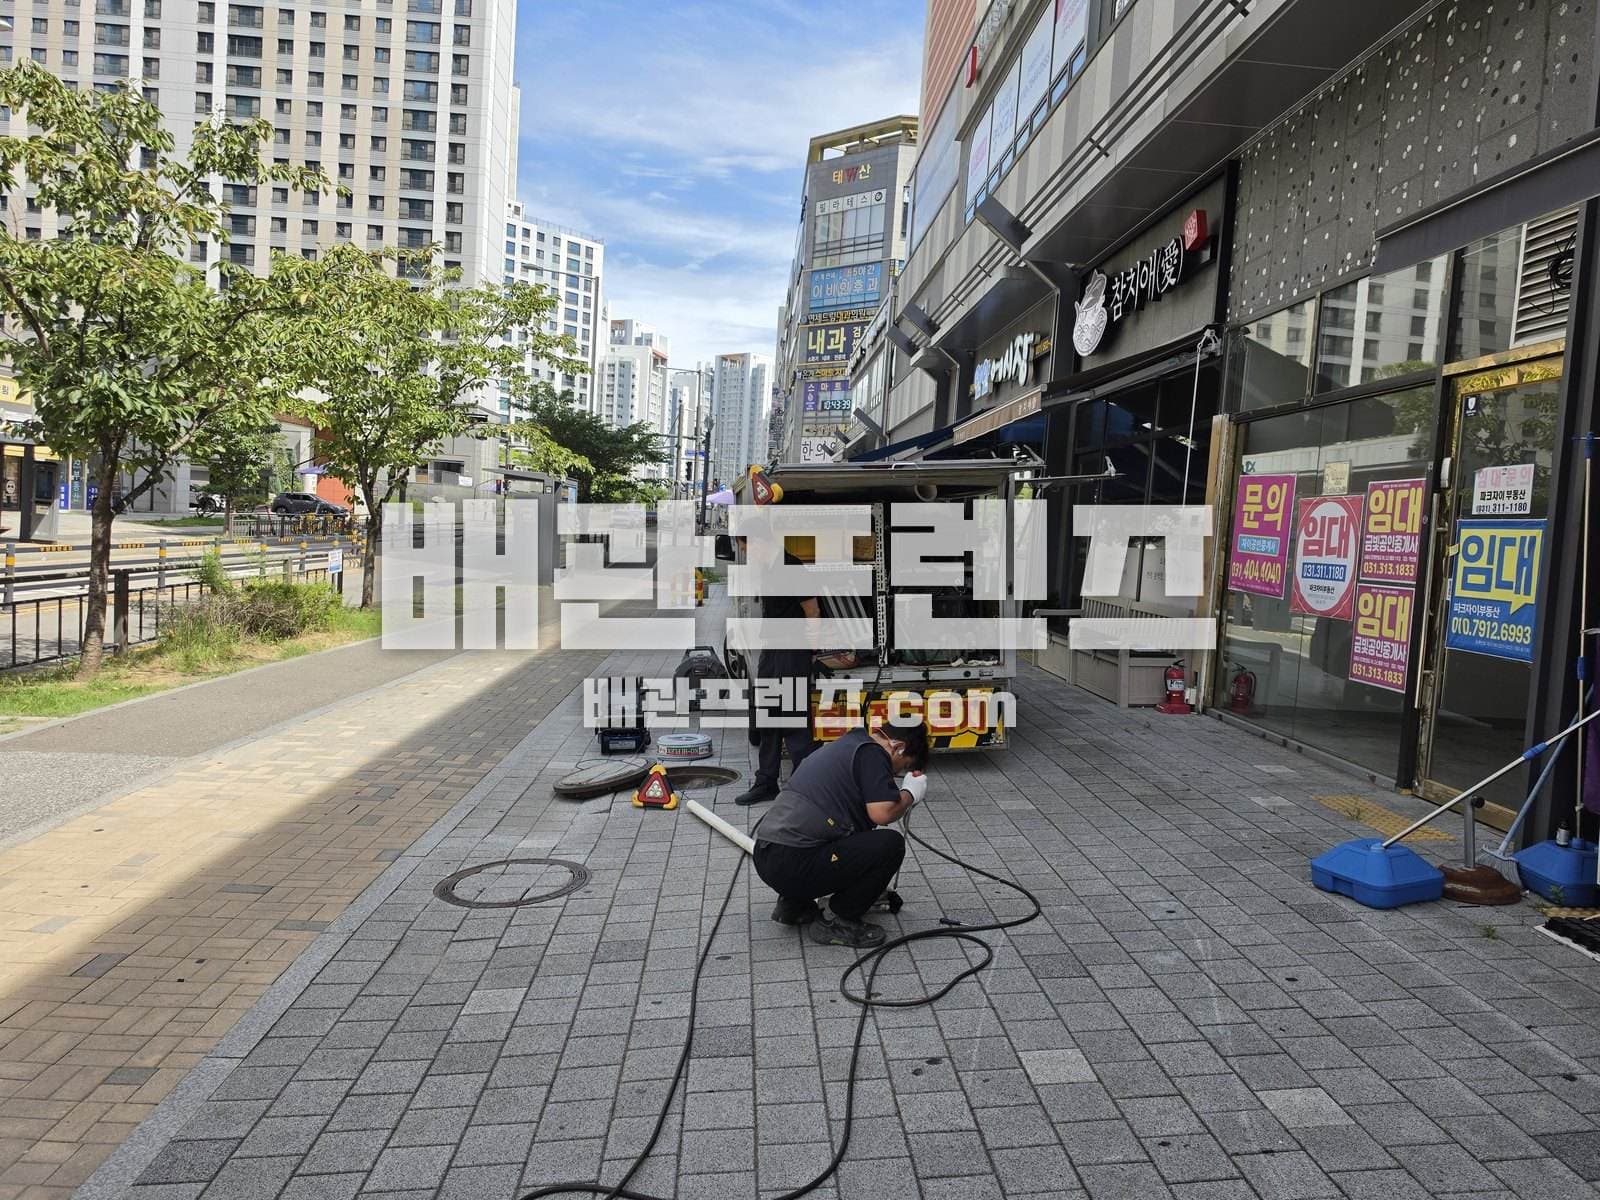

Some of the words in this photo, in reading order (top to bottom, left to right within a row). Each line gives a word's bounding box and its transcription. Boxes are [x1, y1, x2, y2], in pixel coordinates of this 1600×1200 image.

[1110, 236, 1183, 321] 참치애(愛)
[808, 327, 846, 354] 내과
[1243, 483, 1287, 531] 문의
[1368, 487, 1422, 533] 임대
[1492, 502, 1527, 512] 311-1180
[1303, 515, 1348, 559] 임대
[1365, 535, 1418, 553] 금빛공인중개사
[1303, 564, 1344, 580] 031.311.1180
[1363, 562, 1414, 577] 031.313.1833
[1461, 535, 1536, 596] 임대
[1358, 592, 1410, 642] 임대
[1454, 603, 1501, 618] 파크자이부동산
[1451, 617, 1532, 645] 010.7912.6993
[1354, 636, 1406, 662] 금빛공인중개사
[1352, 663, 1403, 685] 031.313.1833
